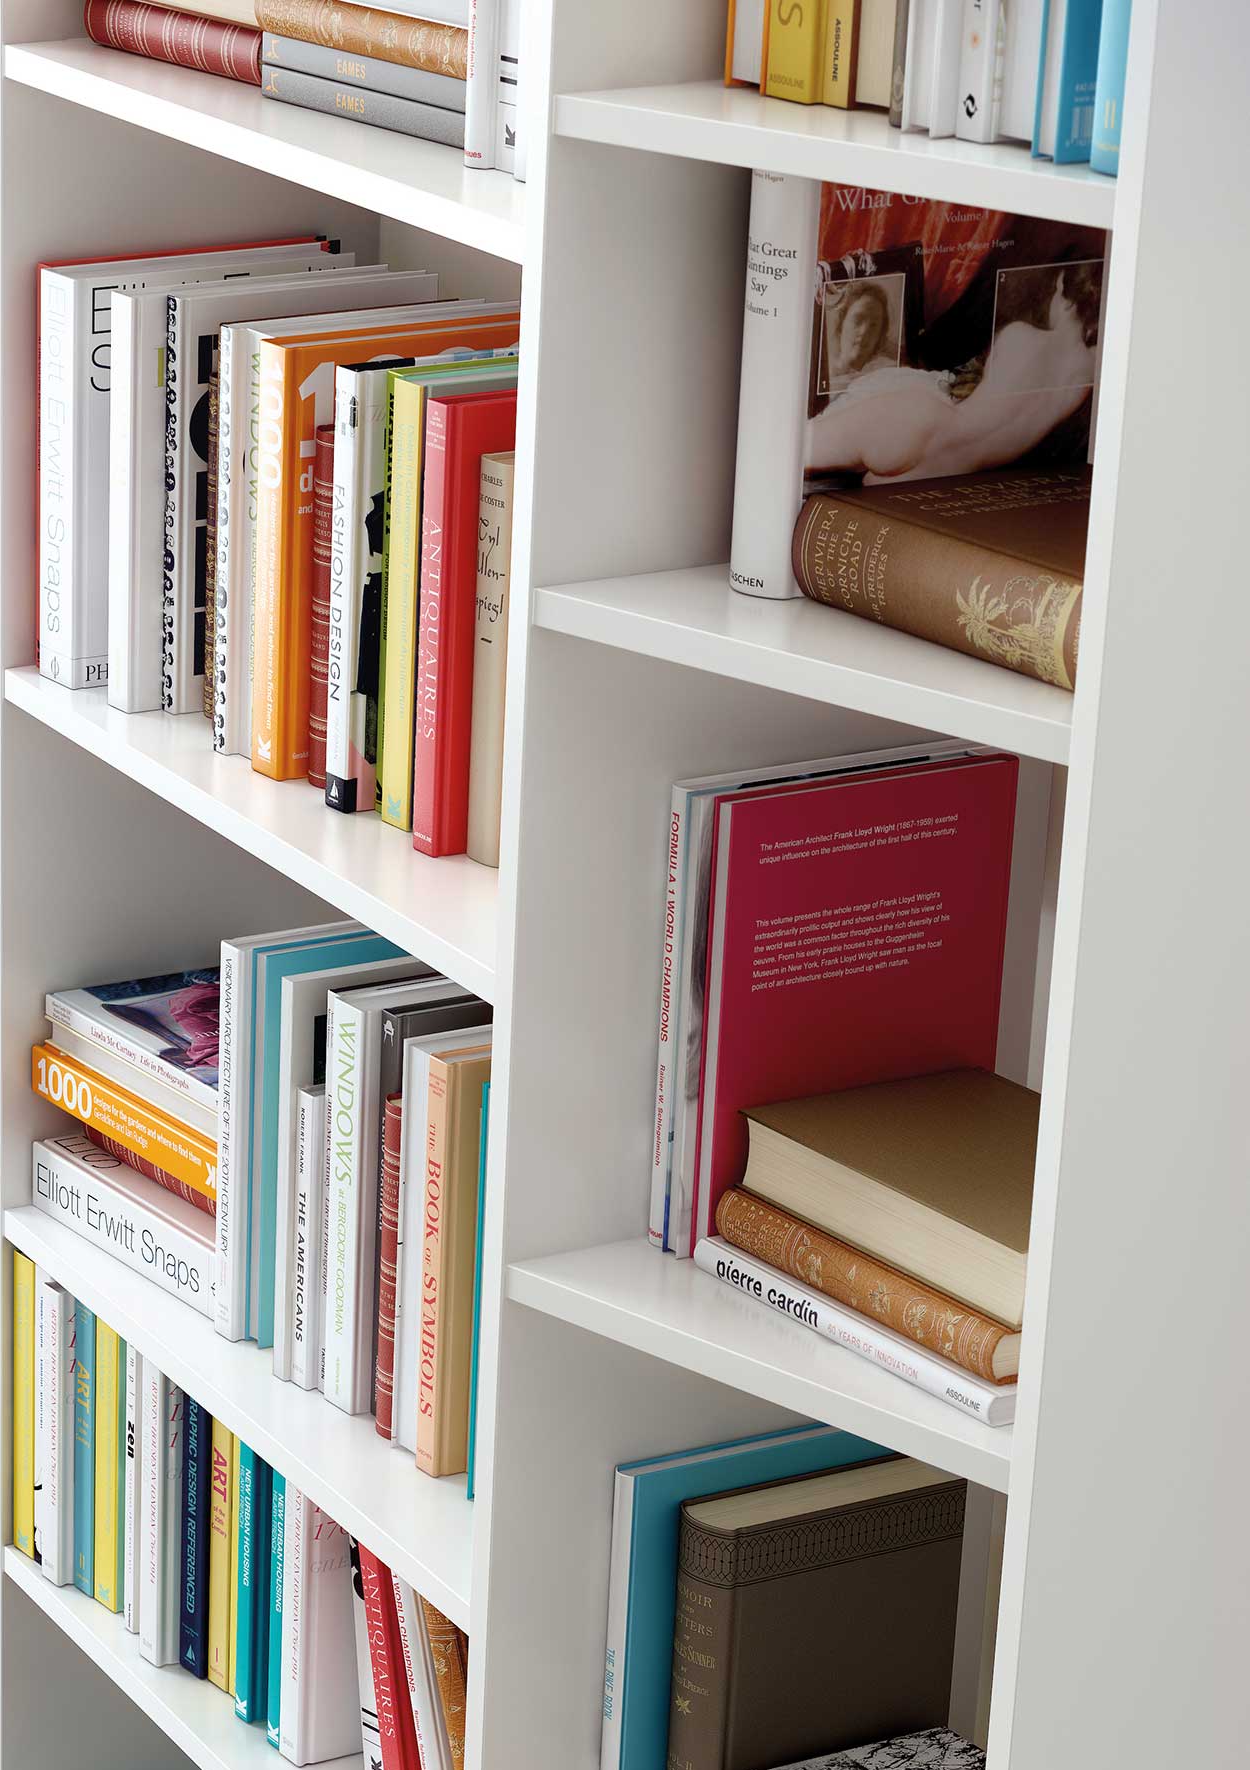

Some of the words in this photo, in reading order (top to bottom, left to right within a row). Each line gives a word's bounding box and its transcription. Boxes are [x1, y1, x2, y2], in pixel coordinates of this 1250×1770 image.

[336, 59, 366, 80] EAMES
[831, 18, 842, 83] ASSOULINE
[335, 92, 366, 114] EAMES
[761, 242, 799, 260] Great
[750, 277, 769, 295] Say
[484, 495, 506, 509] COSTER
[329, 484, 347, 598] FASHION
[839, 521, 859, 609] CORNICHE
[850, 541, 862, 594] ROAD
[876, 553, 889, 607] TREVES
[327, 604, 345, 702] DESIGN
[423, 519, 442, 741] ANTIQUAIRES
[667, 811, 681, 884] FORMULA
[760, 843, 773, 855] The
[774, 839, 804, 852] American
[805, 834, 833, 846] Architect
[833, 831, 853, 842] Frank
[854, 827, 873, 840] Lloyd
[873, 824, 896, 836] Wright
[665, 898, 675, 955] WORLD
[223, 957, 233, 1020] VISIONARY
[660, 956, 673, 1042] CHAMPIONS
[37, 1057, 92, 1119] 1000
[222, 1020, 232, 1111] ARCHITECTURE
[657, 1064, 666, 1093] Rainer
[222, 1110, 231, 1128] OF
[335, 1019, 358, 1188] WINDOWS
[657, 1094, 664, 1105] W.
[126, 1112, 148, 1130] gardens
[146, 1123, 157, 1137] and
[156, 1129, 172, 1146] where
[221, 1127, 231, 1157] THE
[428, 1121, 437, 1152] THE
[654, 1106, 664, 1167] Schlegelmilch
[220, 1157, 231, 1188] 20TH
[220, 1187, 231, 1256] CENTURY
[297, 1191, 306, 1225] THE
[424, 1157, 442, 1243] BOOK
[36, 1160, 83, 1221] Elliott
[85, 1191, 136, 1253] Erwitt
[141, 1226, 200, 1295] Snaps
[336, 1200, 348, 1268] BERGDORF
[425, 1246, 432, 1268] OF
[295, 1232, 306, 1343] AMERICANS
[334, 1267, 346, 1336] GOODMAN
[716, 1258, 762, 1297] pierre
[766, 1286, 819, 1327] cardin
[419, 1271, 438, 1420] SYMBOLS
[77, 1360, 90, 1415] ART
[944, 1387, 981, 1413] ASSOULINE
[127, 1420, 136, 1459] zen
[187, 1460, 197, 1512] DESIGN
[213, 1446, 228, 1504] ART
[243, 1468, 252, 1495] NEW
[243, 1496, 252, 1536] URBAN
[277, 1494, 285, 1521] NEW
[186, 1515, 197, 1614] REFERENCED
[242, 1537, 252, 1588] HOUSING
[276, 1522, 285, 1561] URBAN
[275, 1561, 284, 1614] HOUSING
[366, 1564, 395, 1739] ANTIQUAIRES
